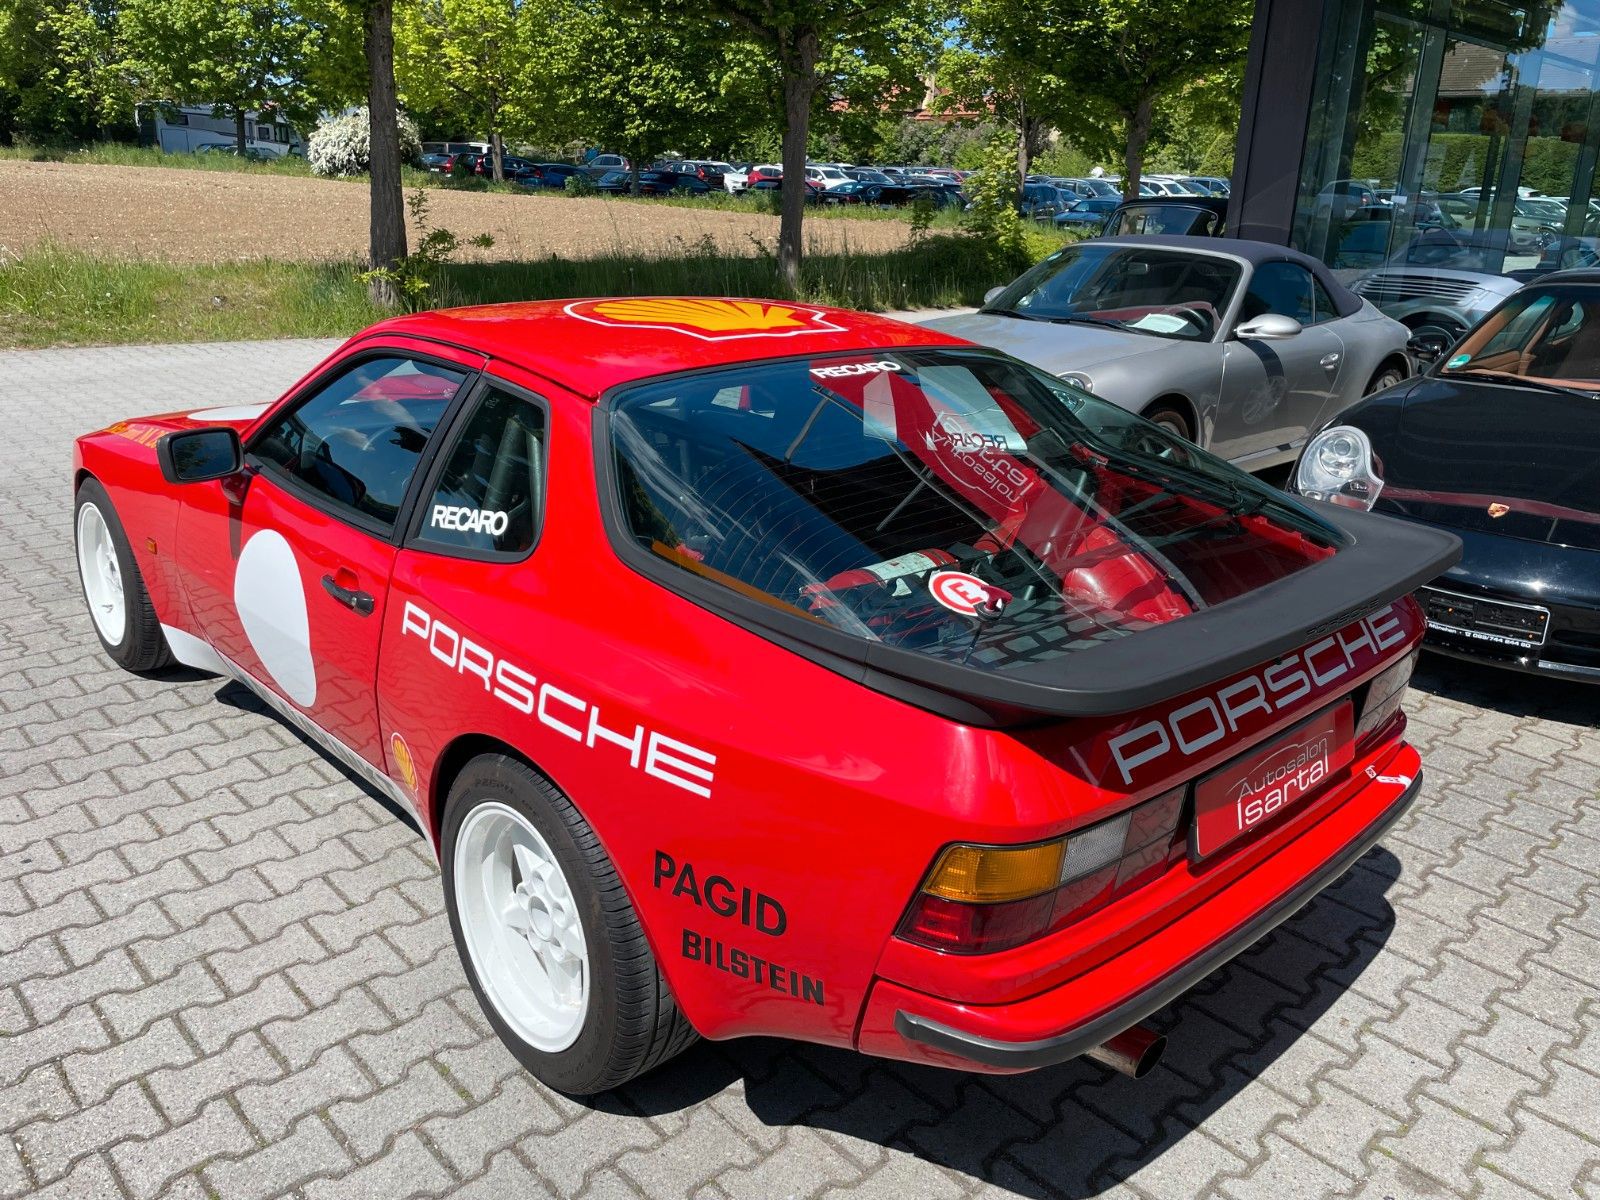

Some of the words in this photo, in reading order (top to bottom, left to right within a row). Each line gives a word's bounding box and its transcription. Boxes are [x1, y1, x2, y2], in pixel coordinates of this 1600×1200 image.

[809, 361, 901, 379] RECARO
[431, 505, 509, 536] RECARO
[947, 582, 985, 605] E
[402, 600, 717, 799] PORSCHE
[1107, 604, 1406, 785] PORSCHE
[1237, 750, 1329, 830] Isartal
[1240, 738, 1328, 797] Autosalon
[653, 848, 787, 937] PAGID
[682, 928, 825, 1006] BILSTEIN
